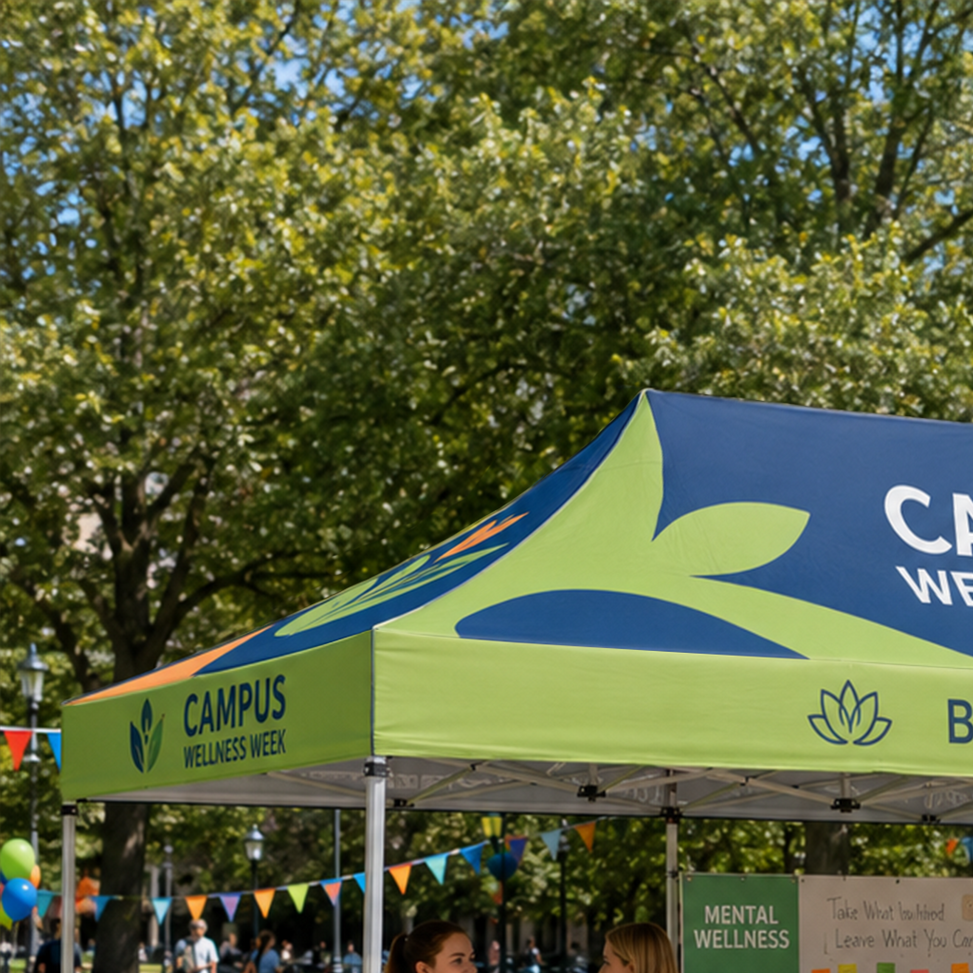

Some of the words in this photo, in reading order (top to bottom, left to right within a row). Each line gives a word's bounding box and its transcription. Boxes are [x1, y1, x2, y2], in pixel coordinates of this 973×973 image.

[184, 674, 287, 738] CAMPUS
[183, 736, 247, 769] WELLNESS
[249, 729, 287, 759] WEEK
[704, 904, 779, 925] MENTAL
[826, 896, 859, 921] Take
[693, 928, 791, 950] WELLNESS
[835, 929, 876, 949] Leave
[881, 929, 918, 949] What
[923, 928, 948, 951] You
